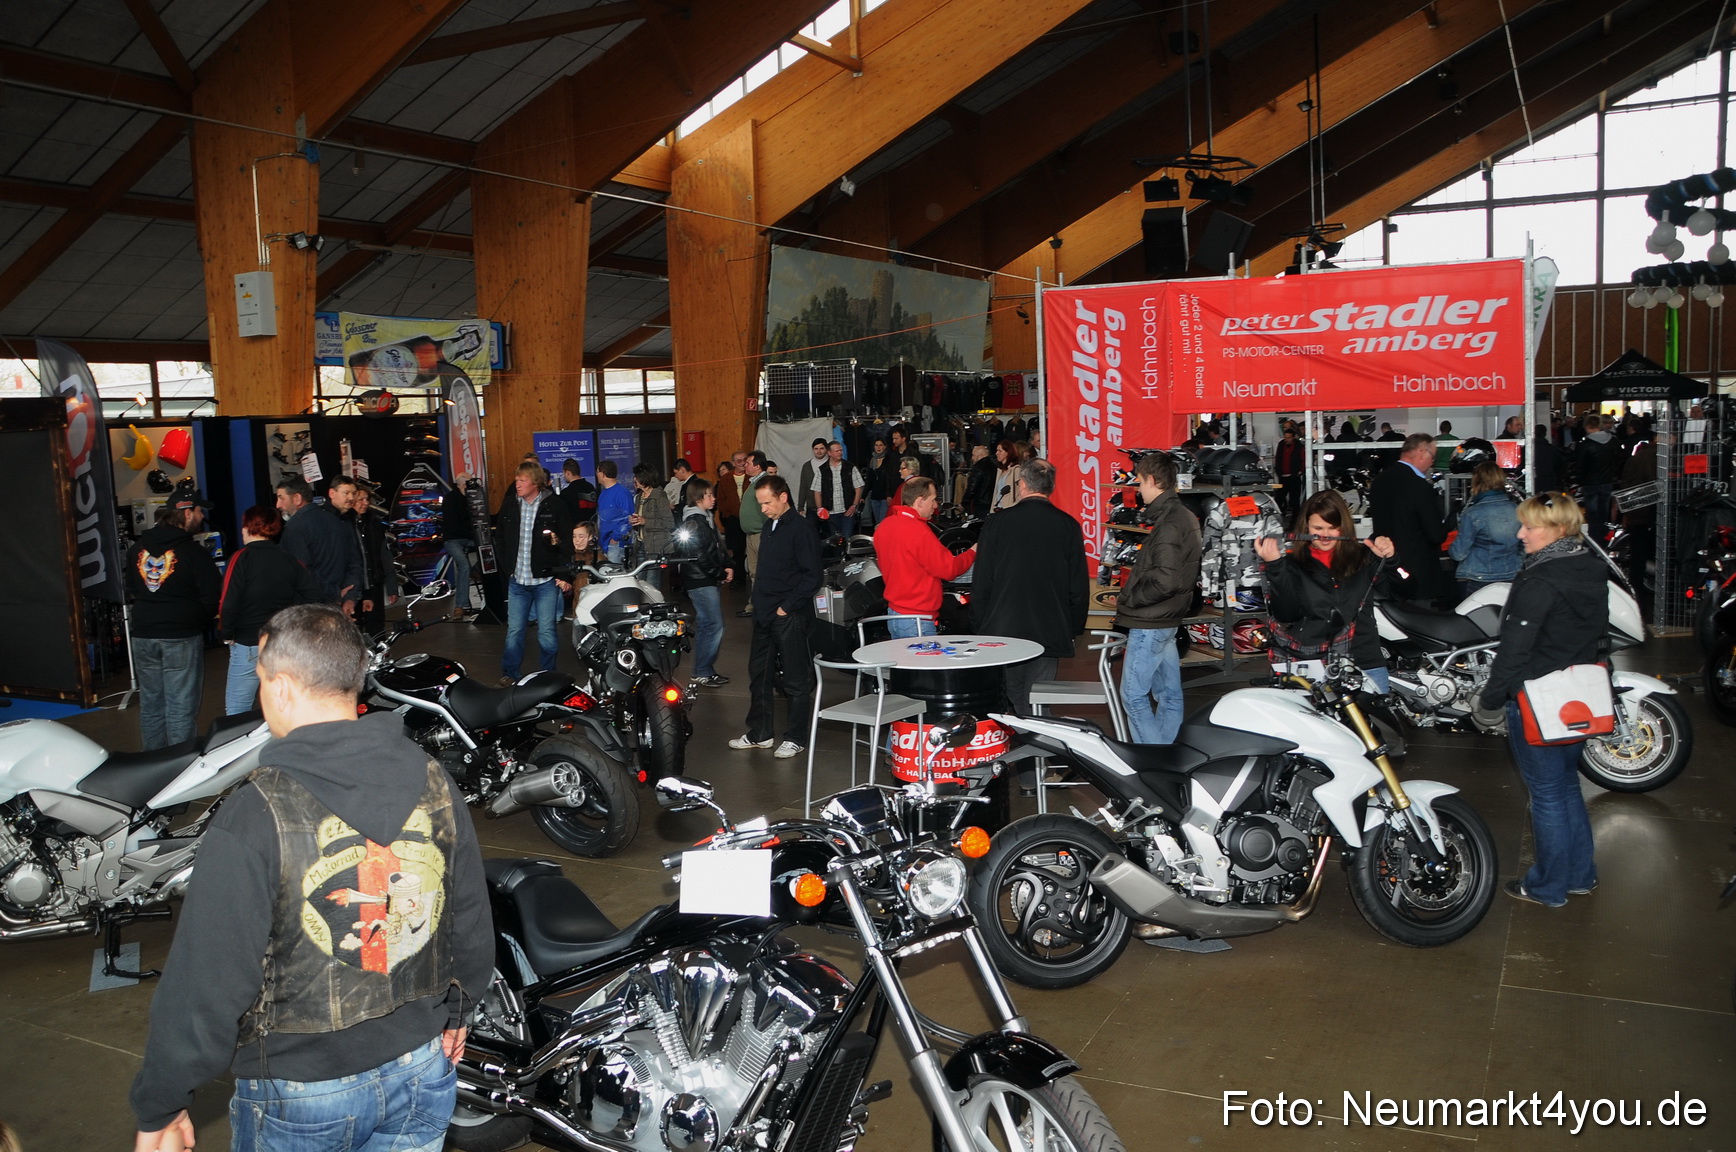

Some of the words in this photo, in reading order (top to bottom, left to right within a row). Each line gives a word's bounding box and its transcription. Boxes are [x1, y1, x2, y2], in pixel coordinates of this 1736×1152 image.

[1190, 294, 1202, 321] Jeder
[1219, 312, 1306, 336] peter
[1304, 295, 1509, 332] stadler
[1180, 319, 1191, 336] gut
[1139, 297, 1158, 400] Hahnbach
[1182, 338, 1192, 354] mit
[1194, 334, 1204, 354] und
[1222, 344, 1324, 358] PS-MOTOR-CENTER
[1341, 330, 1498, 358] amberg
[1072, 300, 1100, 478] stadler
[1103, 307, 1126, 446] amberg
[1195, 366, 1206, 399] Radler
[1223, 378, 1318, 398] Neumarkt
[1394, 372, 1506, 393] Hahnbach
[1618, 386, 1670, 394] VICTORY
[1081, 479, 1100, 560] peter
[309, 848, 359, 885] Motorrad
